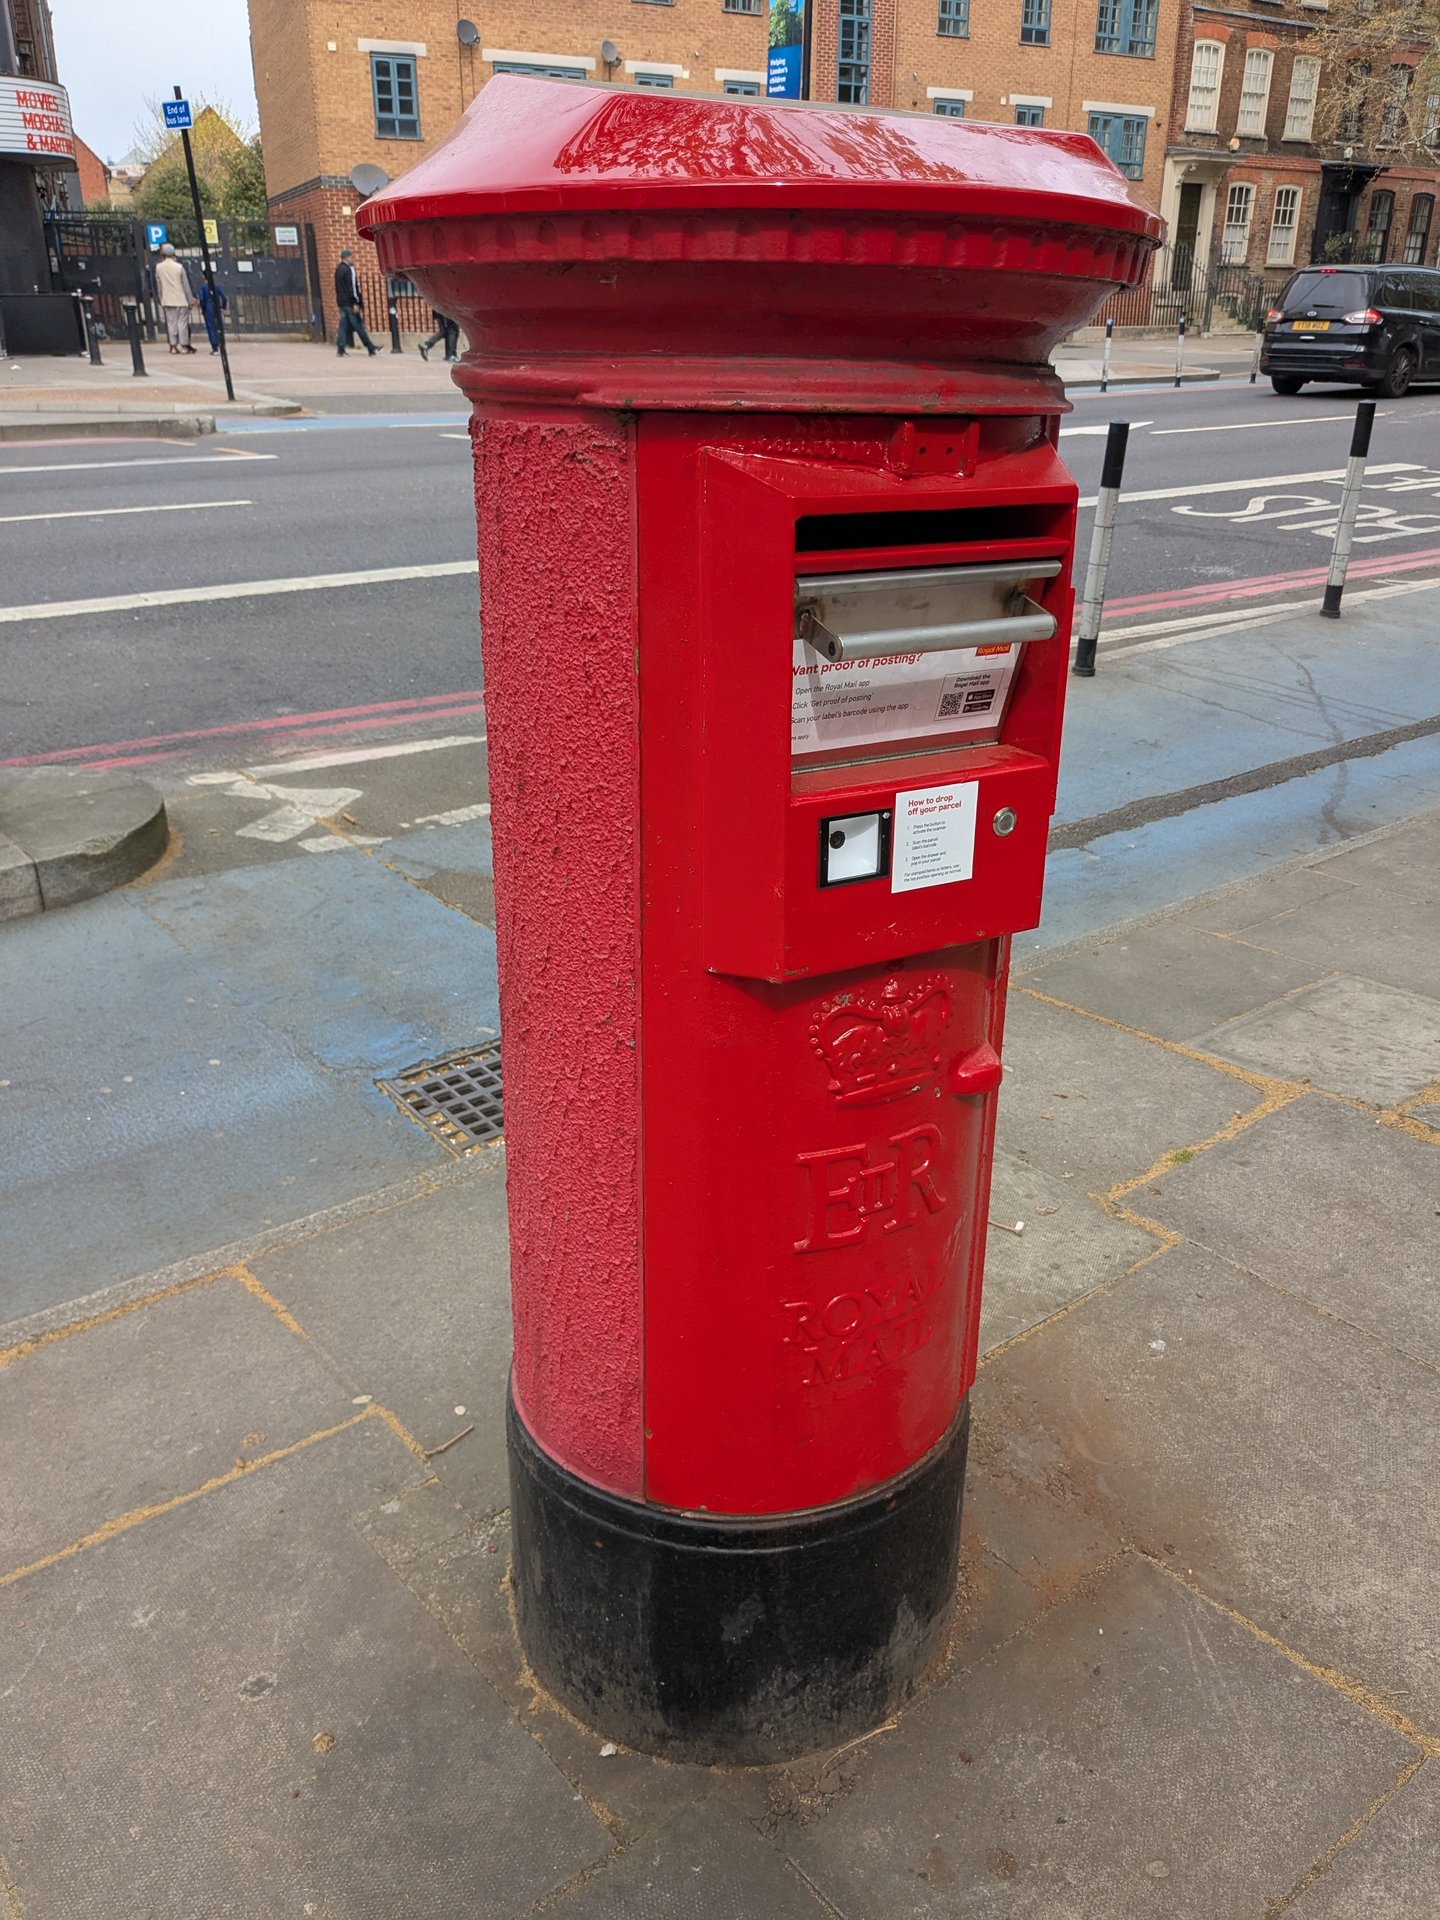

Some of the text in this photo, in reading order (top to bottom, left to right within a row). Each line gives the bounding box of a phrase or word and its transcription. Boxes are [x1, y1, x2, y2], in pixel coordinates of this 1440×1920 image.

[770, 58, 786, 67] Helping
[769, 76, 786, 84] children
[16, 90, 59, 112] MOVIES
[167, 104, 185, 114] End of
[22, 112, 65, 133] MOCHAS
[166, 115, 189, 124] bus lane
[27, 133, 37, 150] &
[150, 226, 162, 242] P
[978, 645, 1010, 655] Royal Mail
[820, 660, 855, 676] proof
[858, 658, 870, 668] of
[872, 652, 923, 669] posting?
[956, 674, 981, 682] Download
[795, 687, 812, 695] Open
[825, 683, 843, 692] Royal
[843, 680, 858, 689] Mail
[858, 680, 870, 688] app
[793, 701, 808, 710] Click
[823, 696, 841, 707] proof
[841, 695, 848, 703] of
[806, 715, 821, 724] your
[822, 711, 841, 719] label's
[843, 708, 867, 717] barcode
[869, 705, 885, 713] using
[887, 703, 896, 711] the
[897, 703, 909, 711] app
[907, 800, 961, 816] off your parcel
[908, 799, 925, 807] How
[935, 795, 953, 803] drop
[781, 1252, 946, 1346] ROYAL
